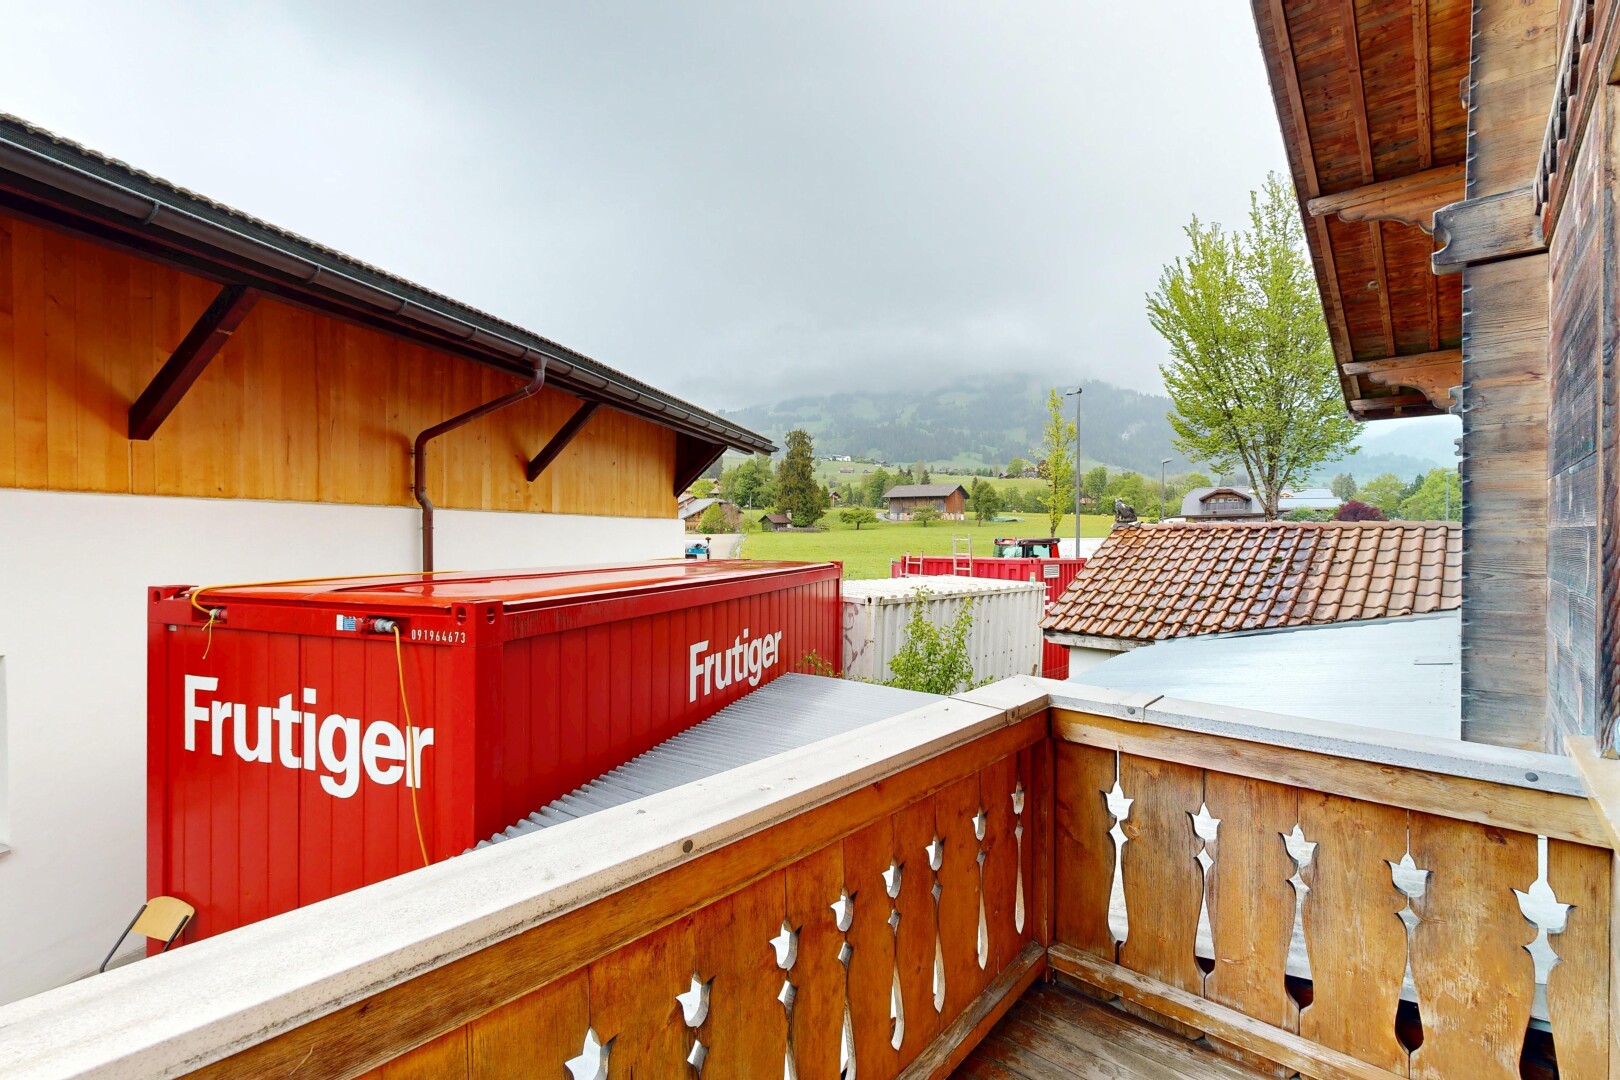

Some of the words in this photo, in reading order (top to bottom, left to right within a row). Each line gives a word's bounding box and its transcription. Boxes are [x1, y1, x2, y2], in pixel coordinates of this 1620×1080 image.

[411, 629, 466, 644] 091964673
[689, 628, 782, 703] Frutiger
[184, 674, 434, 798] Frutiger
